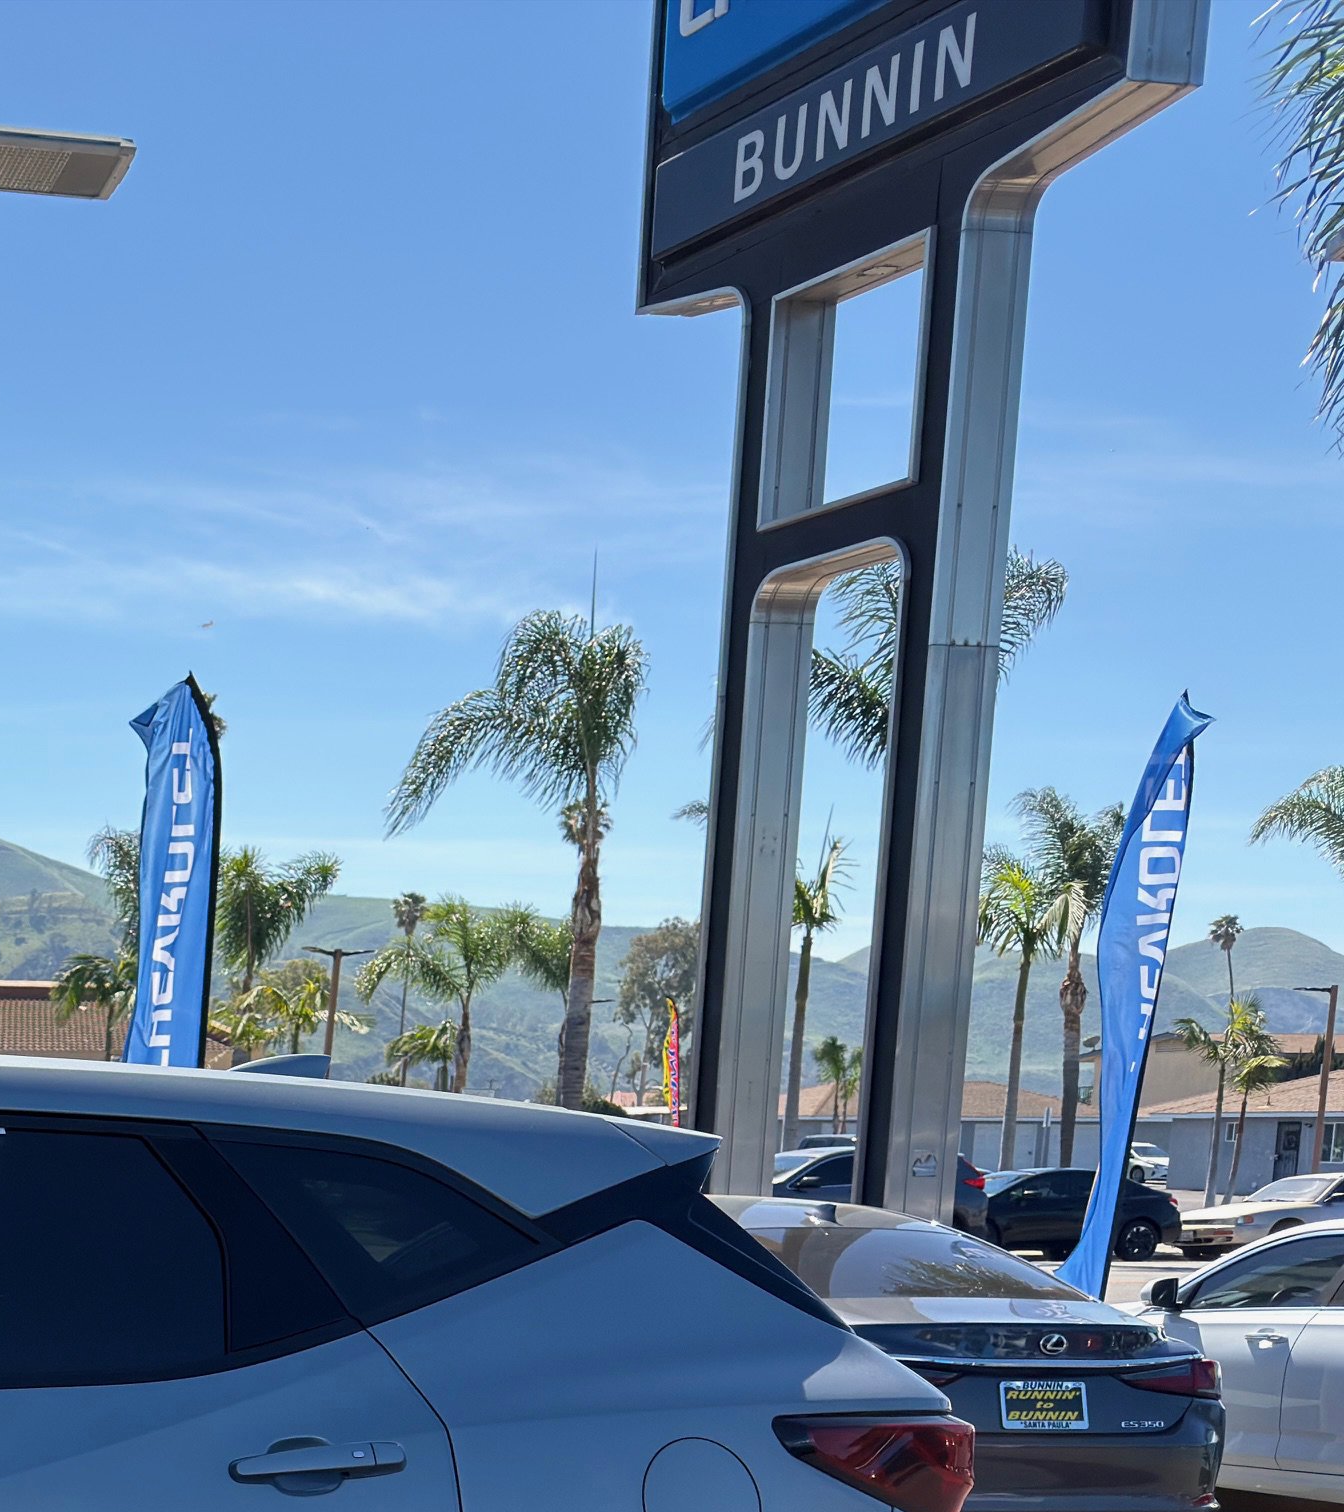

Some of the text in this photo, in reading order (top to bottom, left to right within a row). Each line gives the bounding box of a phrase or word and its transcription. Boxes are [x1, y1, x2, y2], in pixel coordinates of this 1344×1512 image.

[732, 11, 978, 204] BUNNIN
[1022, 1381, 1065, 1390] BUNNIN
[1005, 1390, 1081, 1400] RUNNIN'
[1035, 1400, 1055, 1409] to
[1007, 1410, 1079, 1420] BUNNIN
[1120, 1420, 1164, 1428] ES 350
